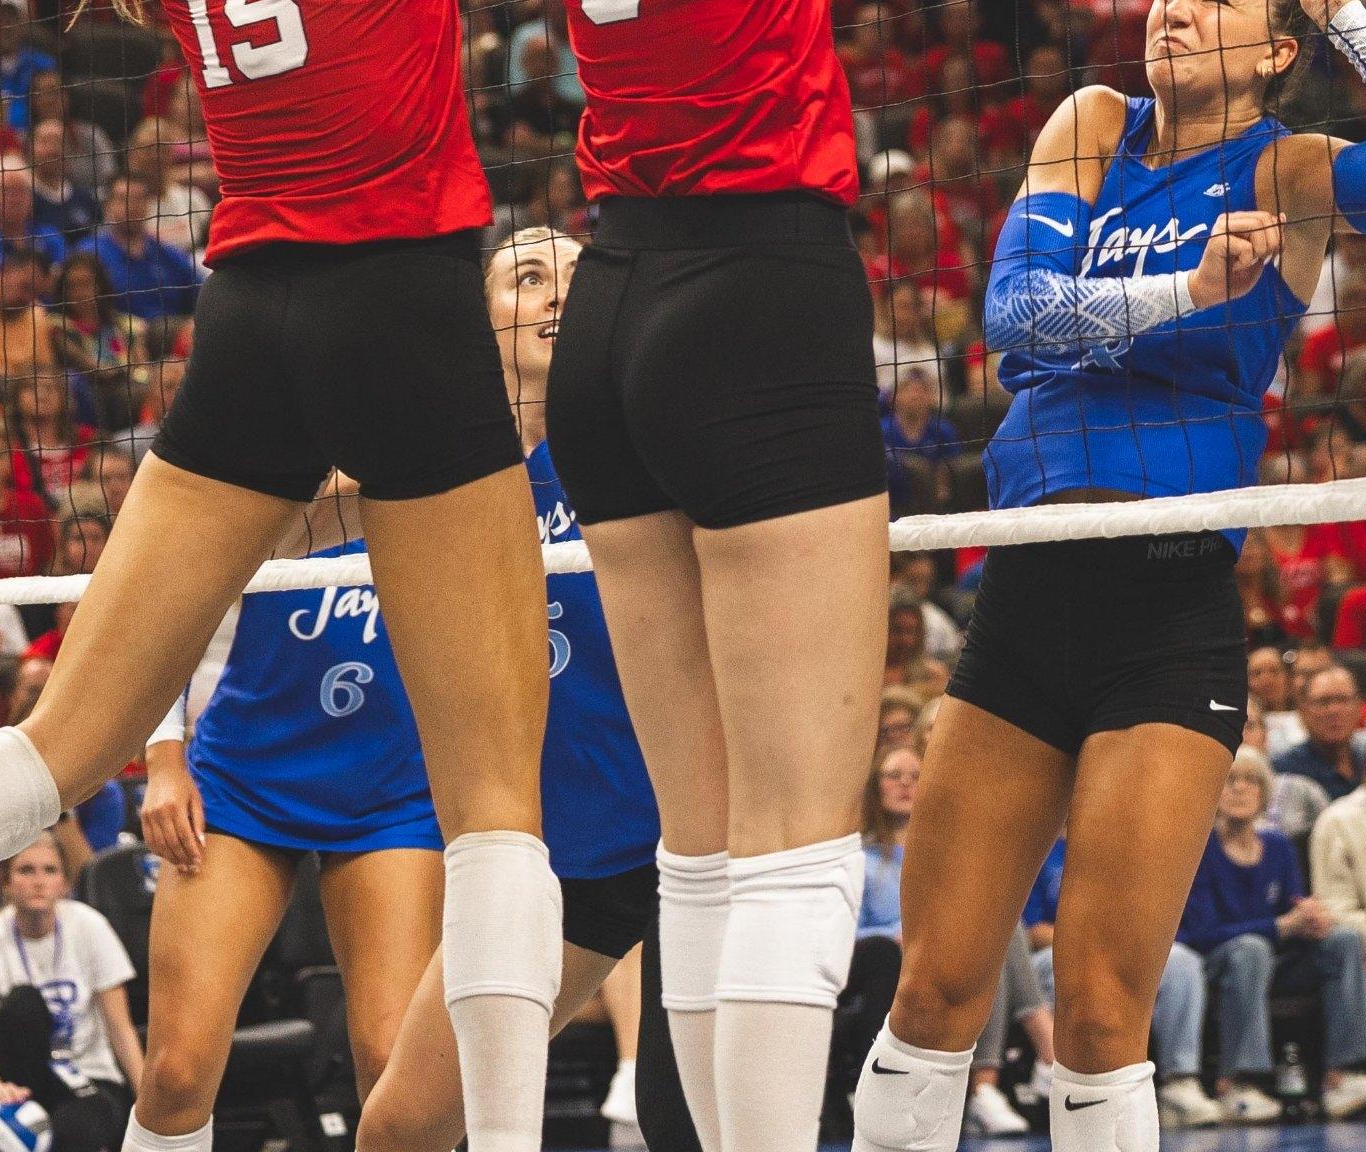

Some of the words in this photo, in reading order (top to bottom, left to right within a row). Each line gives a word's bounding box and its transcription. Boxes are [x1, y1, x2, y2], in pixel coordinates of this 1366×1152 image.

[1078, 207, 1208, 278] Jays
[1147, 539, 1196, 560] NIKE
[288, 586, 380, 644] Jay
[319, 661, 374, 718] 6
